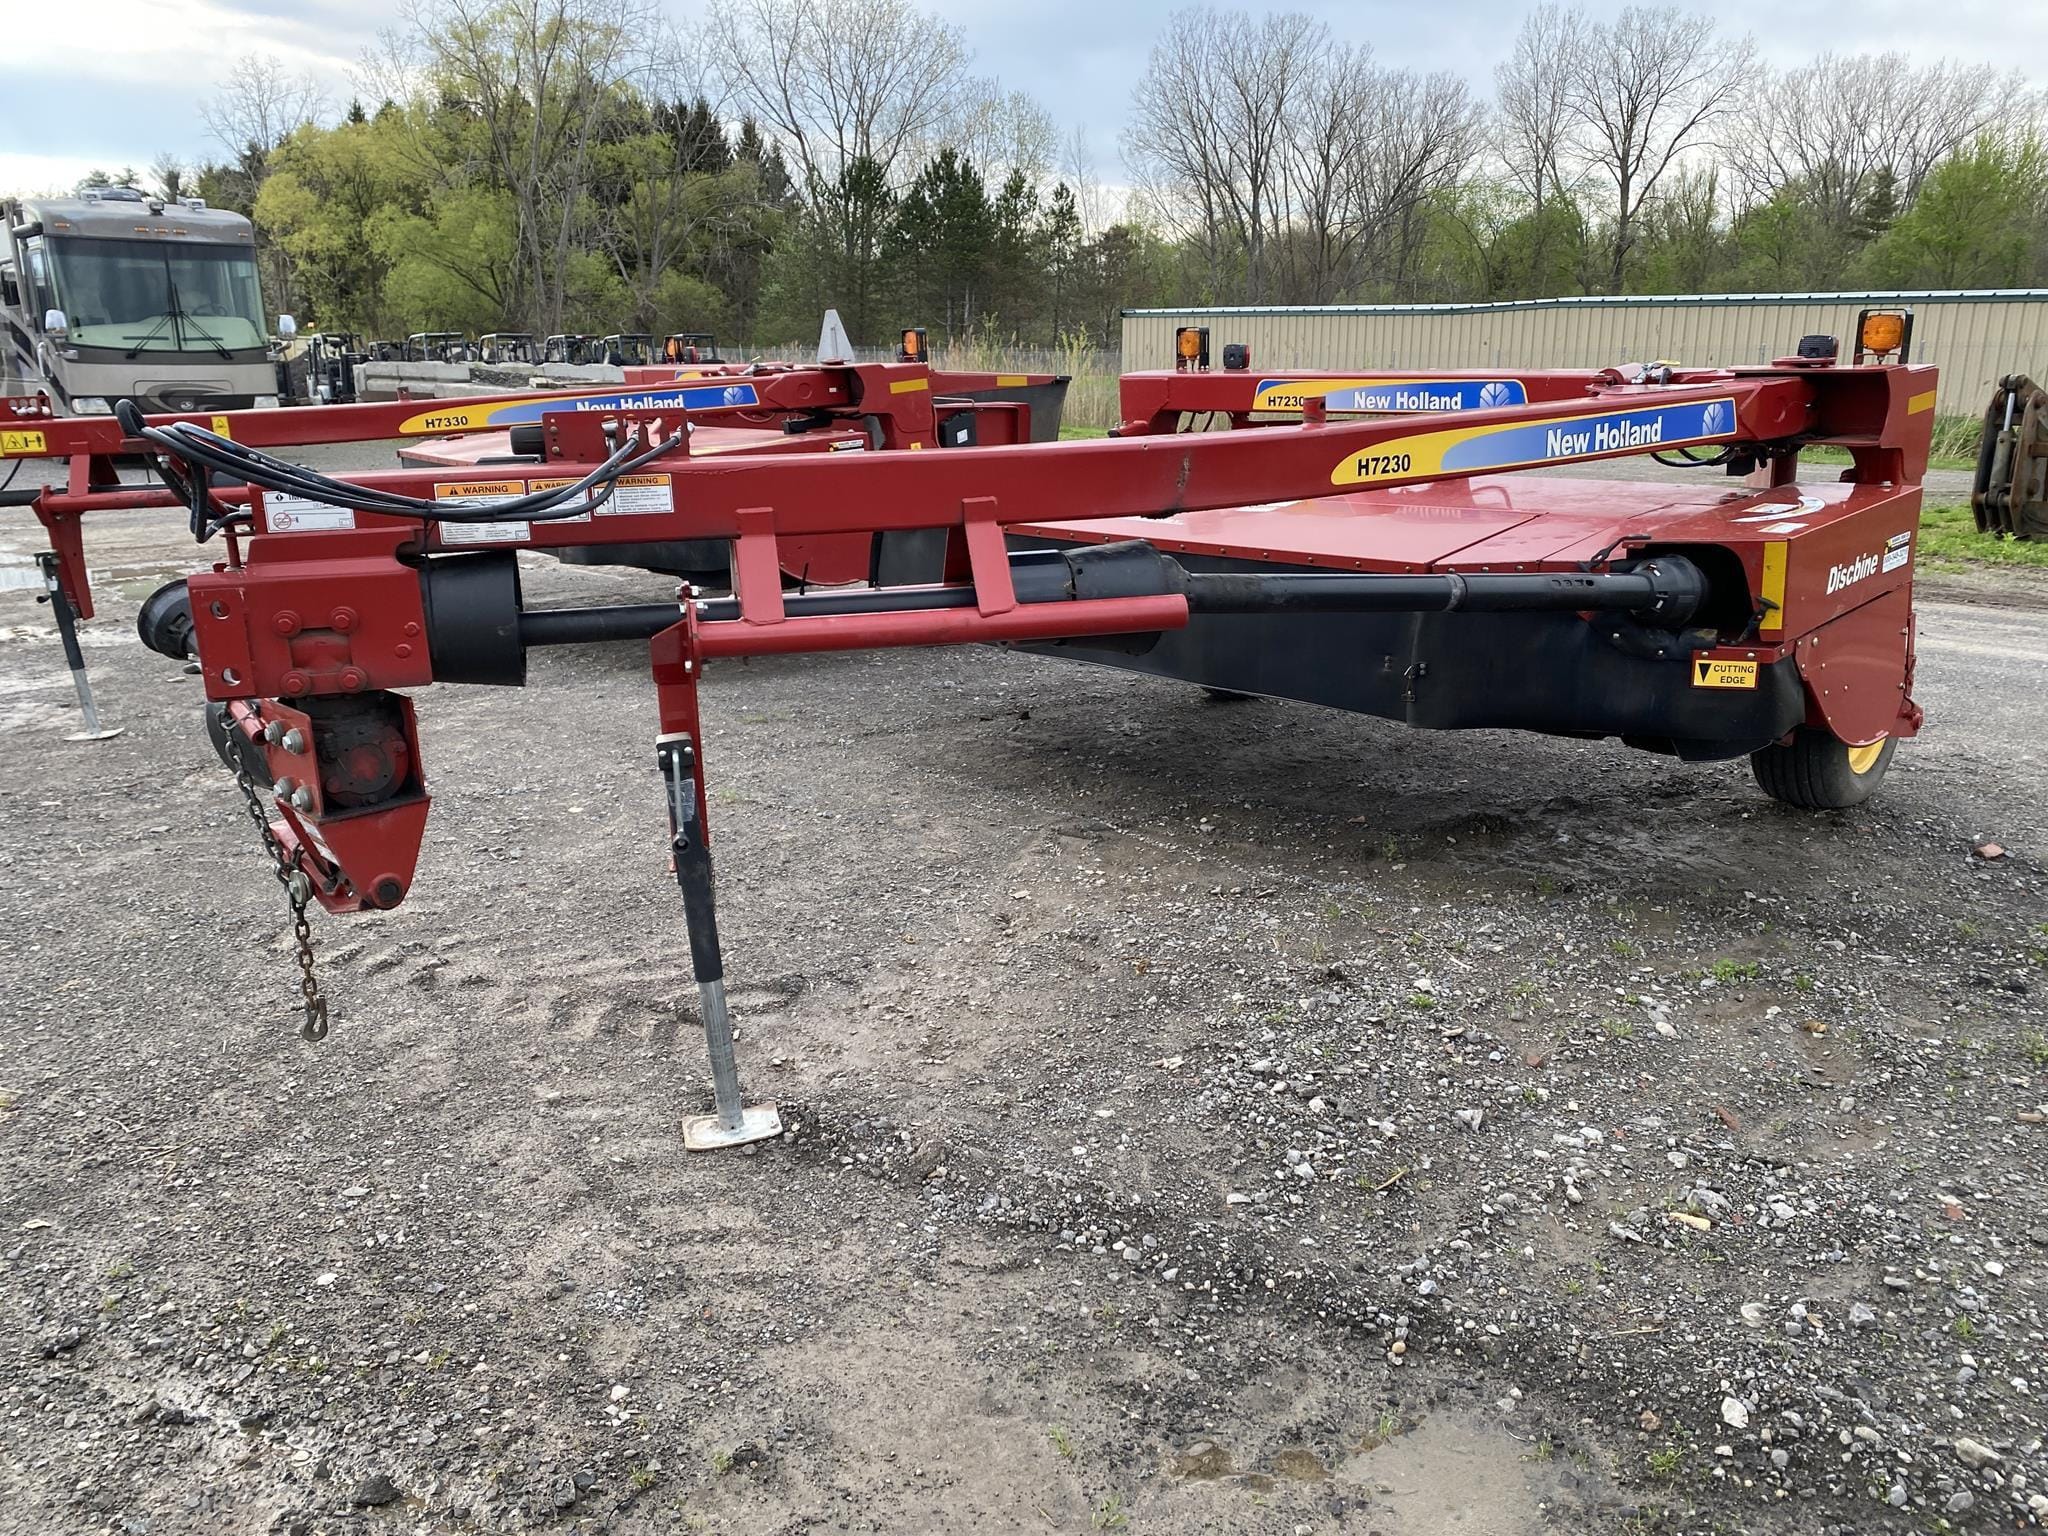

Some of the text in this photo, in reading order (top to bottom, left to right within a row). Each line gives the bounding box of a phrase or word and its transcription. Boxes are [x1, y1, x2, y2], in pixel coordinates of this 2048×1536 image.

[1354, 392, 1388, 409] New
[1396, 391, 1462, 410] Holland
[425, 416, 468, 429] H7330
[620, 394, 684, 410] Holland
[1357, 416, 1663, 477] H7230 New Holland
[617, 477, 658, 485] WARNING
[463, 485, 509, 494] WARNING
[1826, 552, 1878, 595] Discbine
[1713, 664, 1754, 674] CUTTING
[1720, 676, 1746, 684] EDGE
